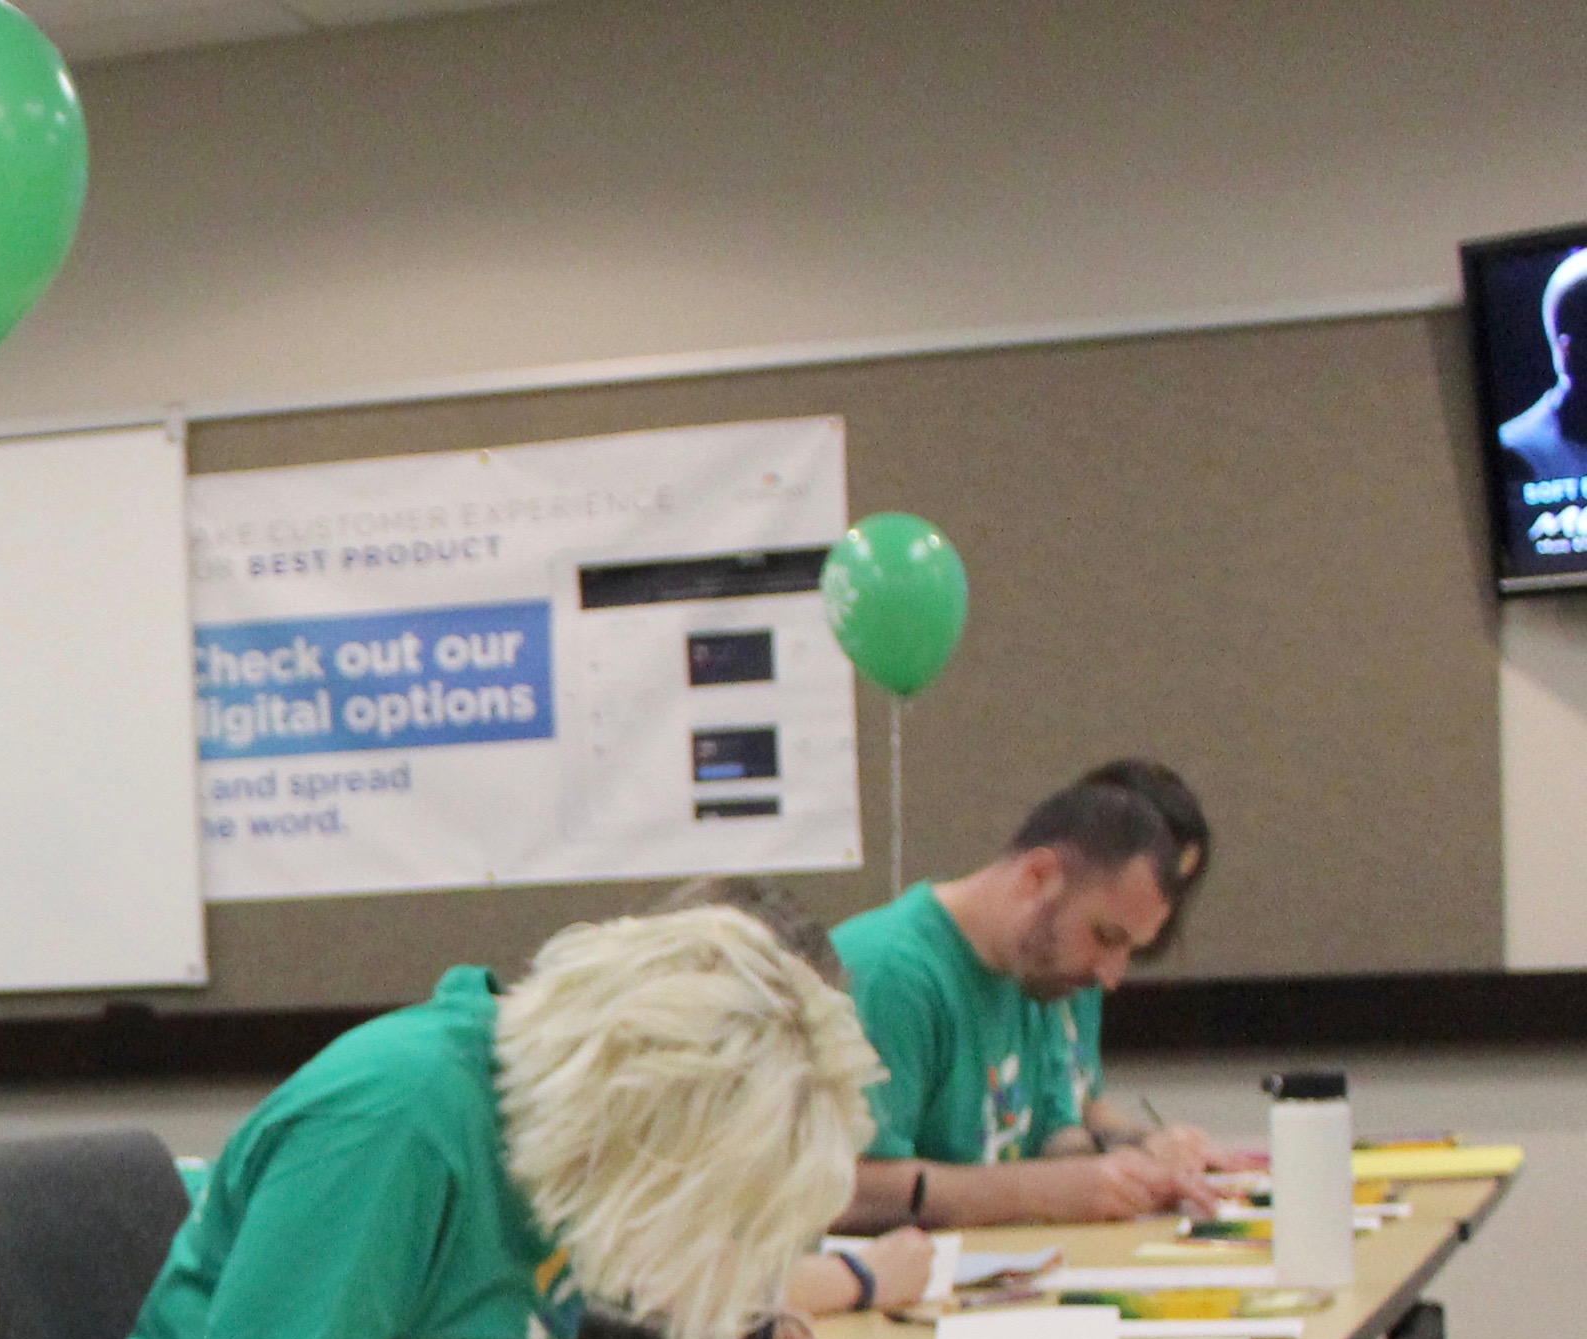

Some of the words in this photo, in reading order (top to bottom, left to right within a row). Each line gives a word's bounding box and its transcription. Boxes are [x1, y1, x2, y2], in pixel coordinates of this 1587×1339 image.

[190, 518, 253, 549] AKE
[268, 504, 448, 543] CUSTOMER
[462, 487, 676, 528] EXPERIENCE
[248, 548, 329, 577] BEST
[341, 534, 503, 569] PRODUCT
[334, 631, 423, 679] out
[434, 630, 525, 673] our
[343, 680, 538, 739] options
[290, 760, 413, 801] spread
